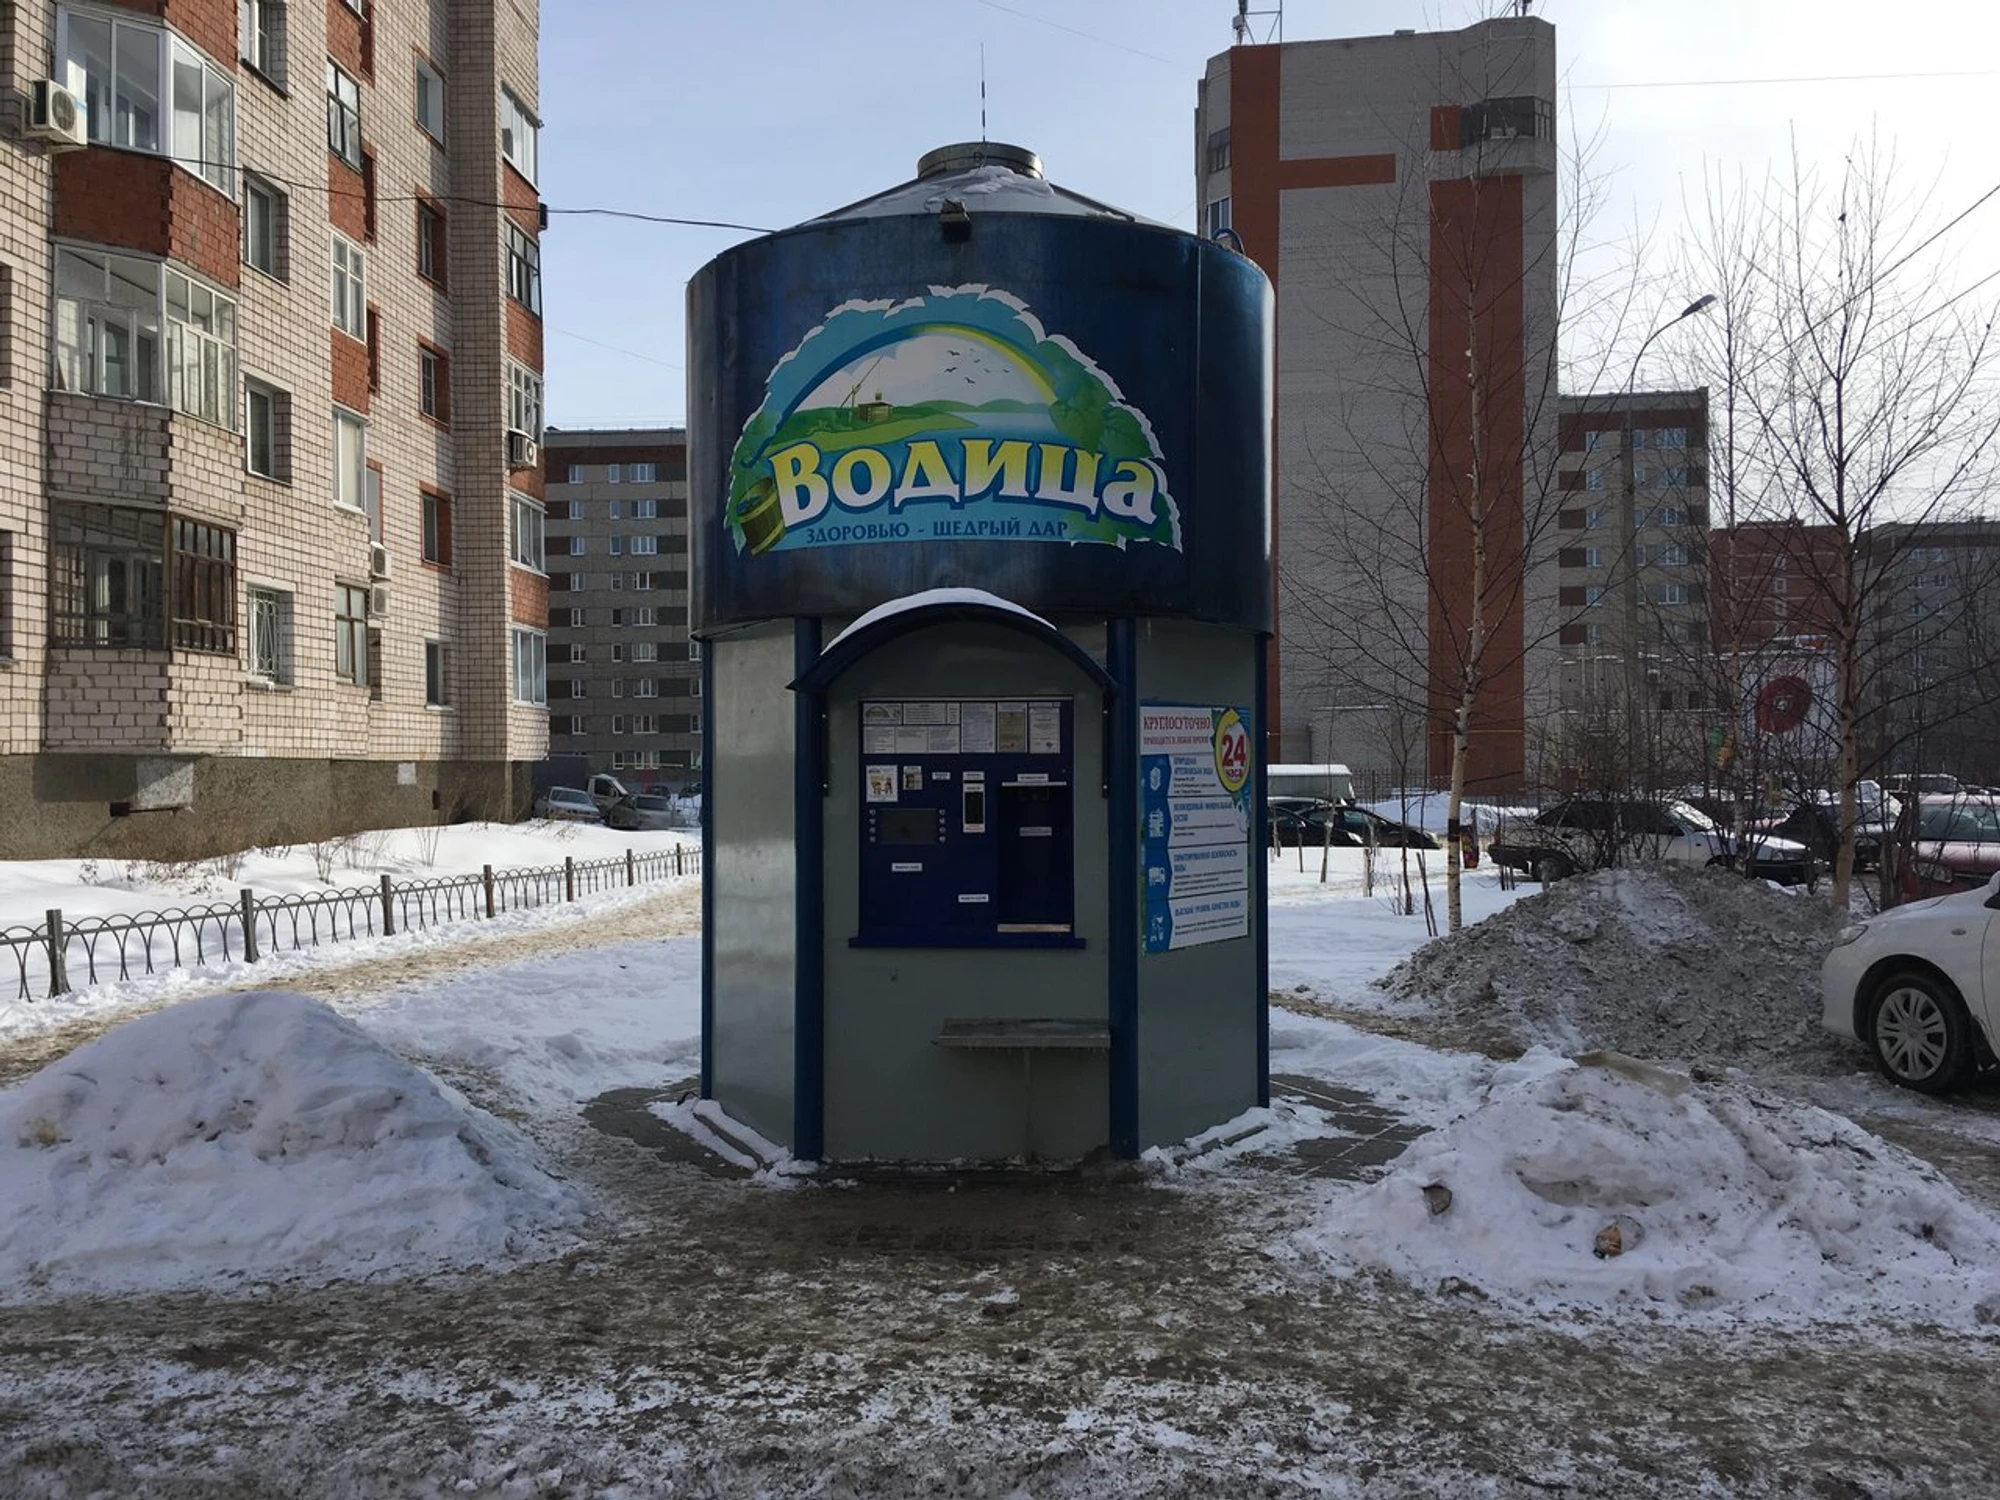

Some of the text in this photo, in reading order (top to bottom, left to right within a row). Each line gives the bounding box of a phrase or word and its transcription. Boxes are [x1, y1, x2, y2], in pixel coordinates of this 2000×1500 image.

[806, 522, 910, 544] ЗДОРОВЬЮ
[933, 517, 1021, 537] ЩЕДРЫЙ
[1028, 520, 1068, 537] ДАР
[1222, 735, 1246, 766] 24
